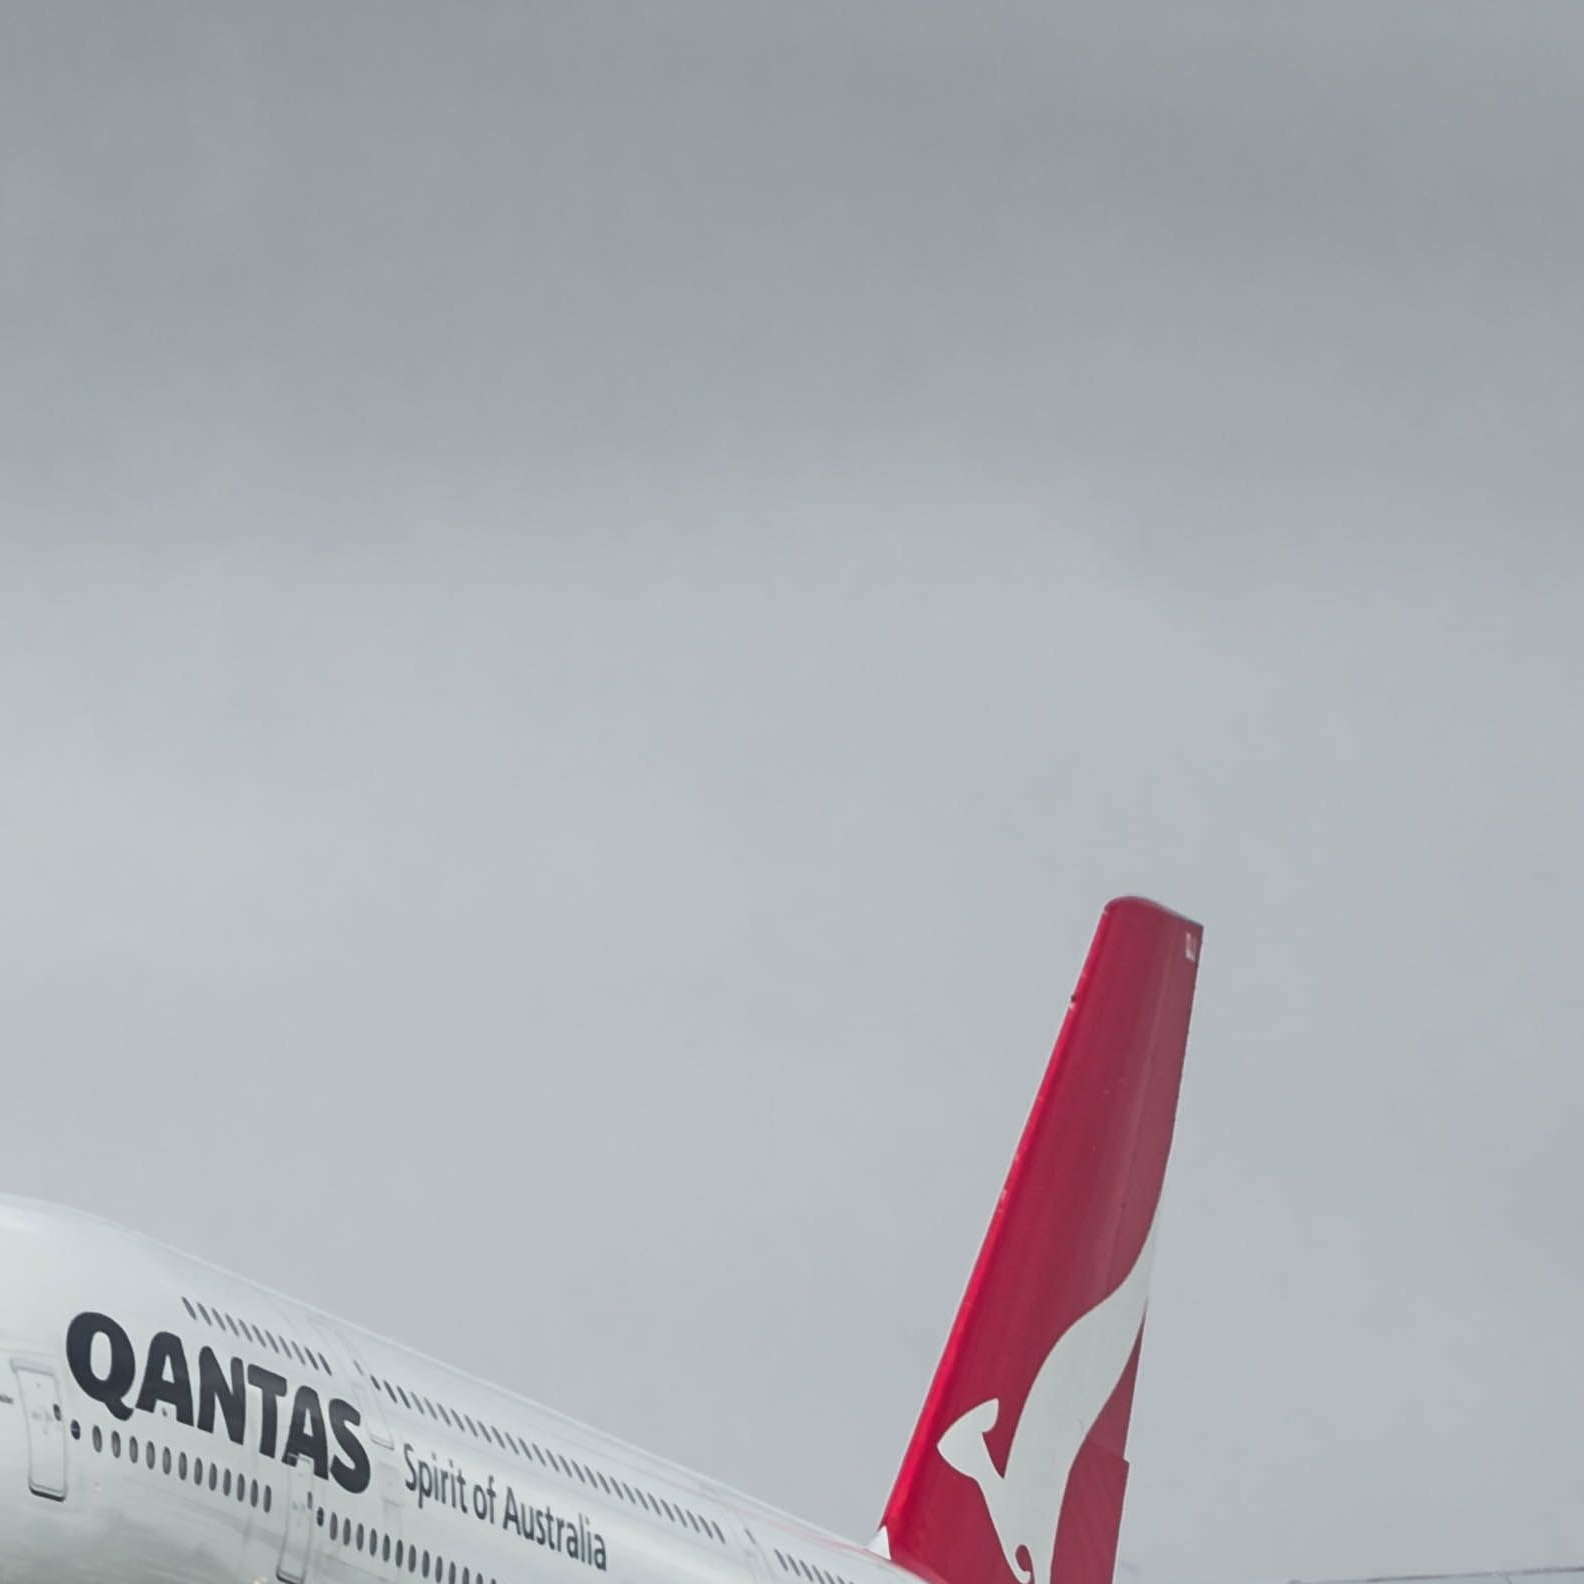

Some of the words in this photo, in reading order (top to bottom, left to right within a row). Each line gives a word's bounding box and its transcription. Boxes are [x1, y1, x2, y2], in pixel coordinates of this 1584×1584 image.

[66, 1312, 371, 1494] QANTAS
[403, 1442, 468, 1515] Spirit
[473, 1474, 497, 1525] of
[502, 1485, 607, 1572] Australia
